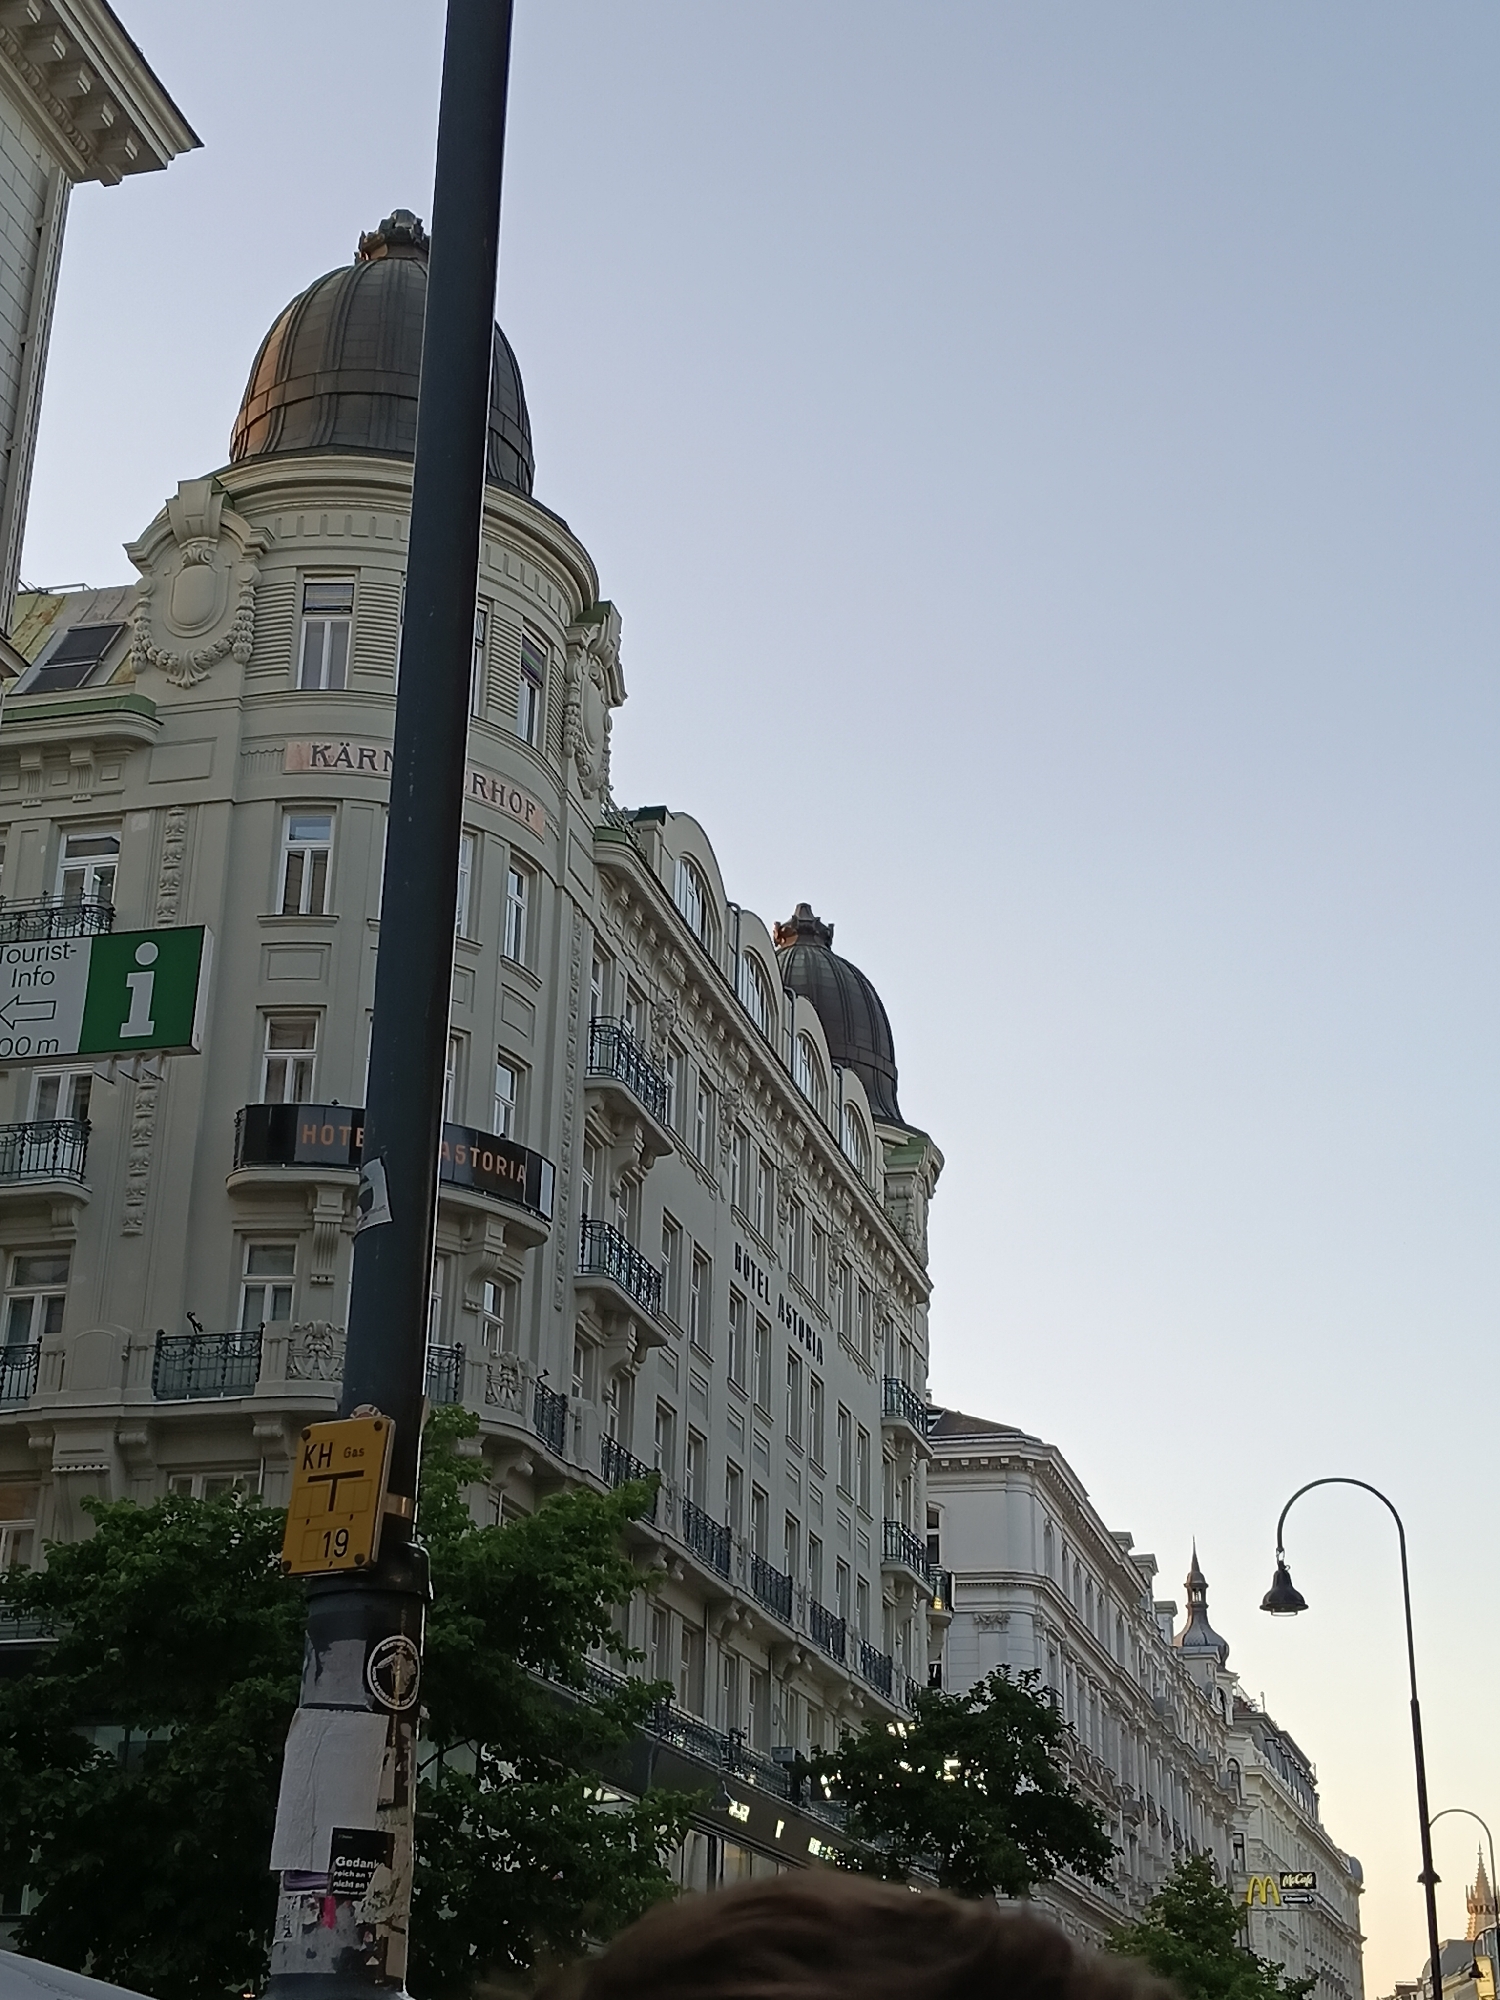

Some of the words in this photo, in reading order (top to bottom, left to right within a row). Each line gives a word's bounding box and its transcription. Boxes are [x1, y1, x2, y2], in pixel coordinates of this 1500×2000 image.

[310, 742, 536, 822] KÄRNRHOF
[0, 941, 77, 965] Tourist-
[11, 965, 55, 988] Info
[37, 1039, 59, 1054] m
[302, 1124, 365, 1147] HOTE
[441, 1141, 526, 1184] ASTORIA
[777, 1292, 824, 1366] ASTORIA
[303, 1442, 333, 1471] KH
[343, 1446, 365, 1459] Gas
[323, 1528, 349, 1558] 19
